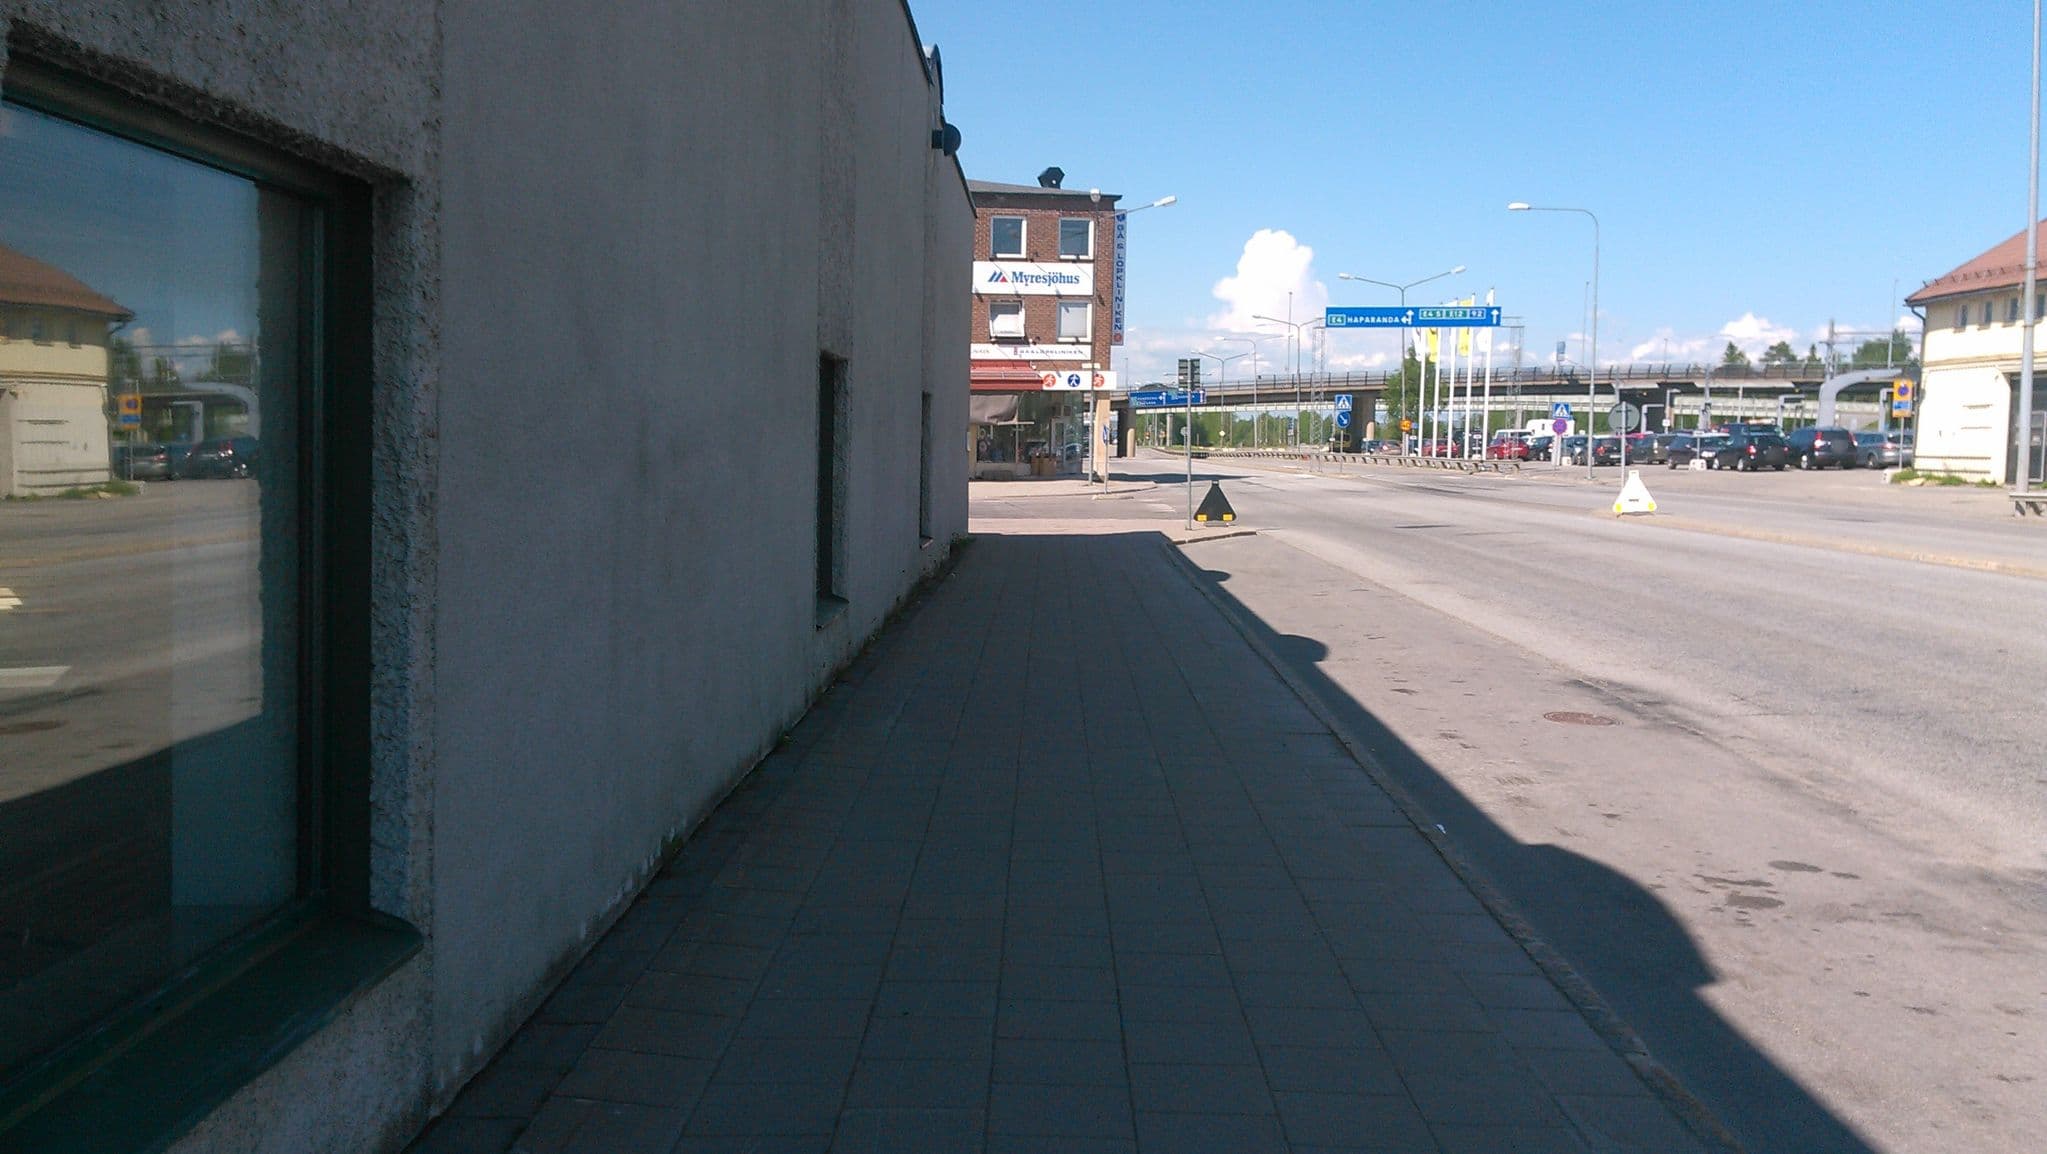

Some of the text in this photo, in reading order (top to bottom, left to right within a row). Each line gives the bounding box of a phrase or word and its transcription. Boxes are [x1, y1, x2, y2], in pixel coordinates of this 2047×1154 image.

[1011, 271, 1080, 287] Myresjöhus
[1331, 316, 1400, 324] E4 HAPARANDA
